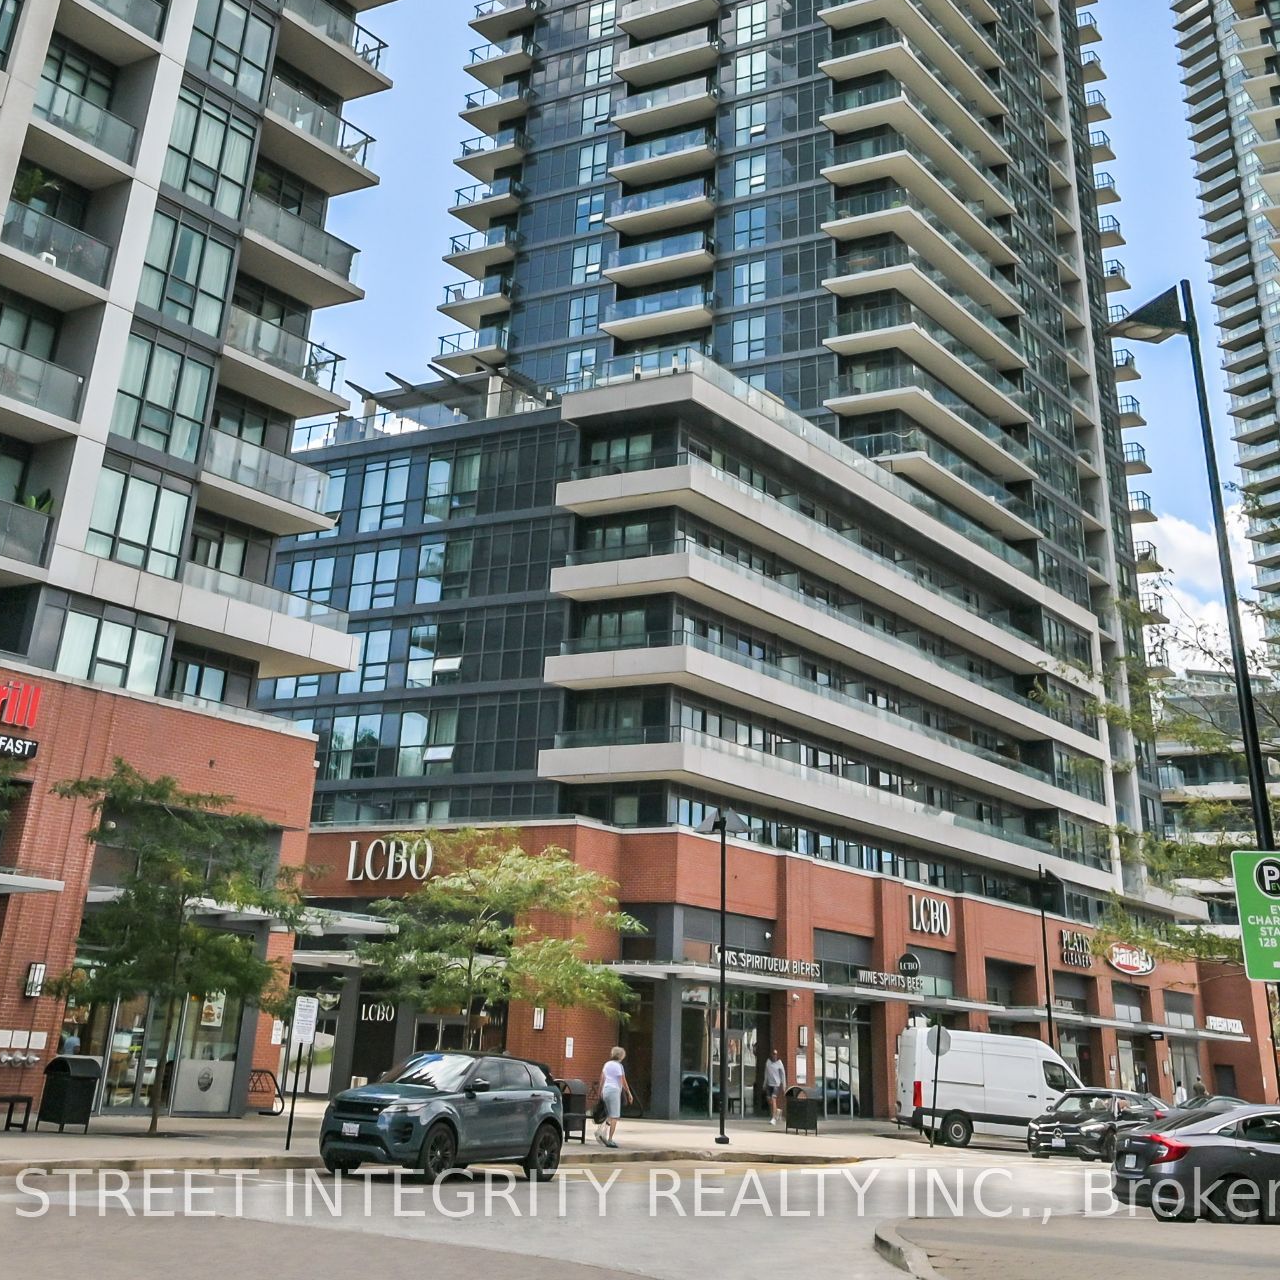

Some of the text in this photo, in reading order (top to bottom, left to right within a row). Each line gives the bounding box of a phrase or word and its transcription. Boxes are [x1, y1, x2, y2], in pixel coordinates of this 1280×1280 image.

[346, 838, 433, 881] LCBO
[911, 894, 951, 937] LCBO
[1259, 937, 1278, 948] 128
[739, 952, 790, 973] SPIRITUEUX
[899, 962, 918, 971] LCBO
[1062, 951, 1093, 969] CLEANERS
[859, 970, 925, 990] WINE SPIRITS BEER
[361, 1002, 395, 1022] LCBO
